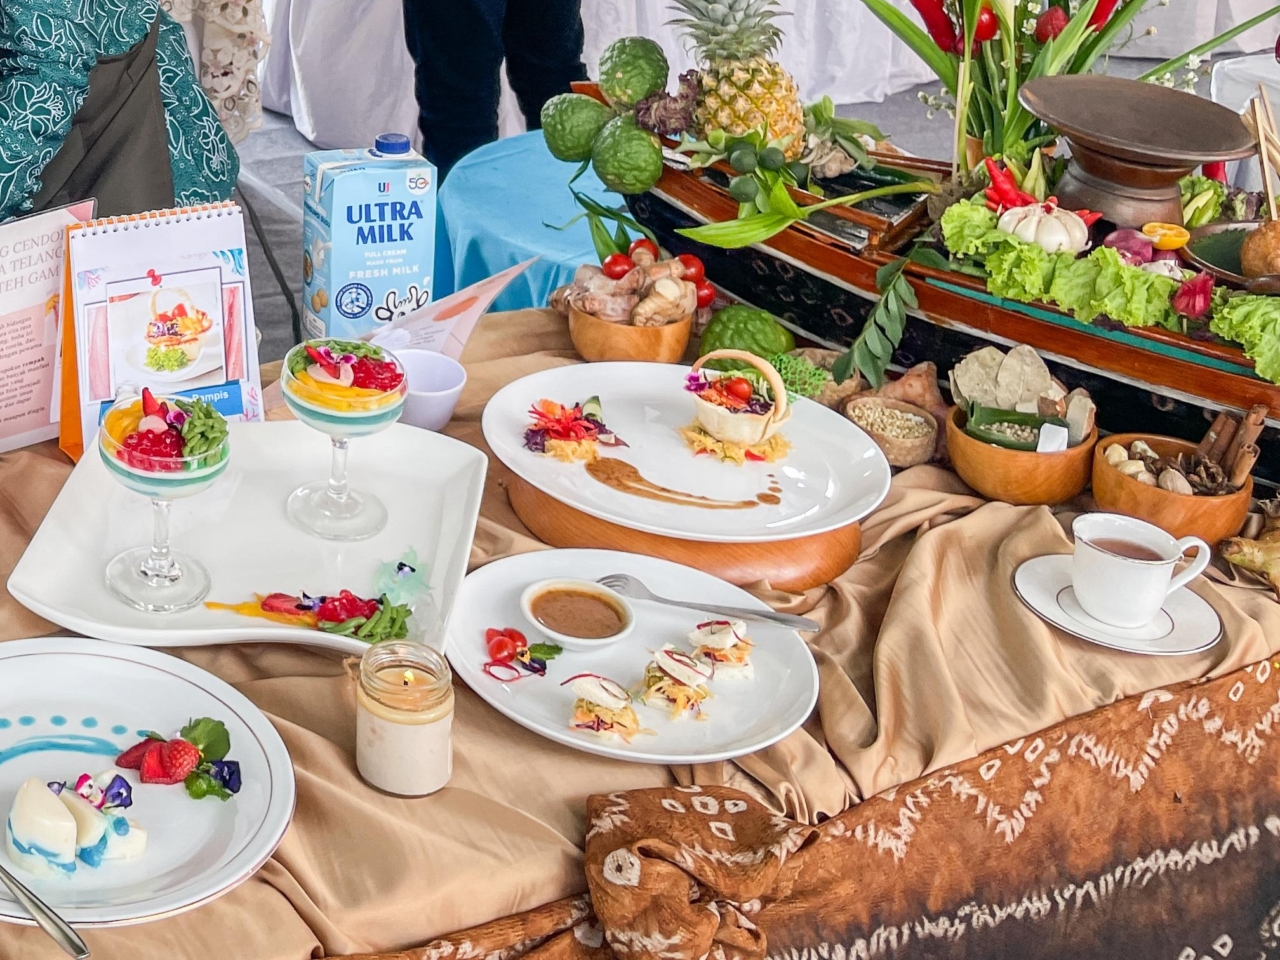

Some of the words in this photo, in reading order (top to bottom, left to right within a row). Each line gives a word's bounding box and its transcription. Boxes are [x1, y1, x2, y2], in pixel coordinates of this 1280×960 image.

[346, 200, 423, 224] ULTRA
[356, 222, 414, 245] MILK
[382, 249, 407, 257] CREAM
[28, 265, 60, 285] GAM
[349, 268, 389, 279] FRESH
[392, 264, 420, 276] MILK
[6, 315, 32, 328] hidangan
